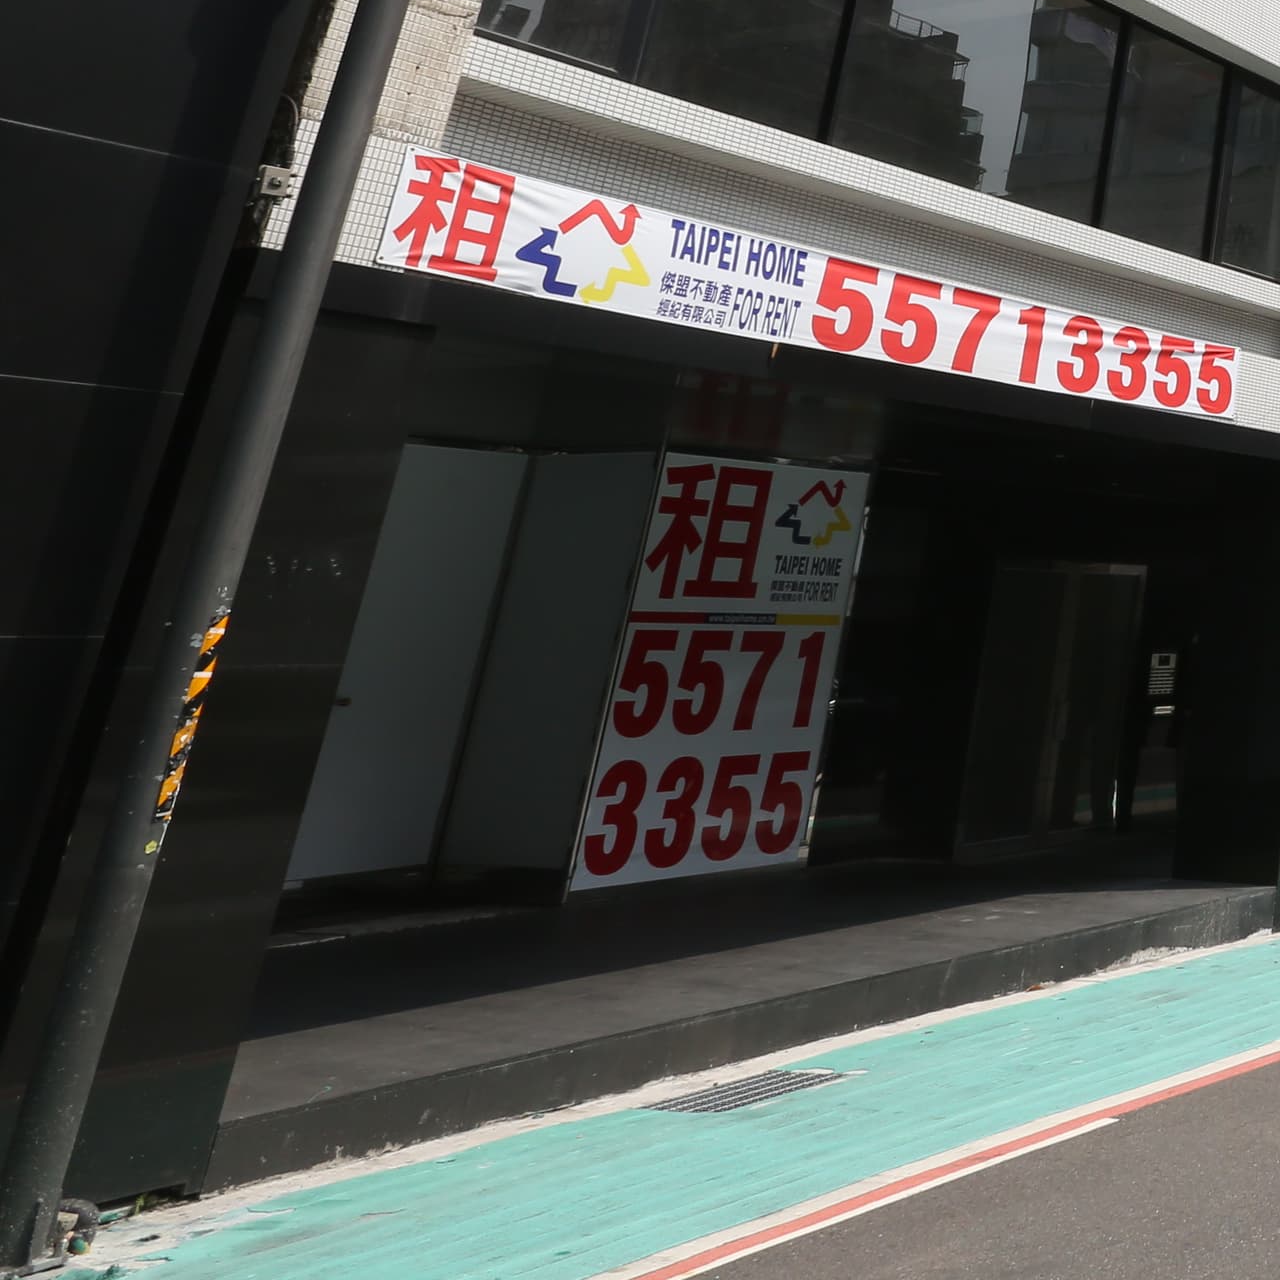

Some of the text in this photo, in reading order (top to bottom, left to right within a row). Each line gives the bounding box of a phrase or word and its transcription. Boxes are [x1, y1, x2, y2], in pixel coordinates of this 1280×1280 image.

[393, 155, 516, 282] 租
[671, 218, 808, 287] TAIPEI HOME
[659, 271, 734, 307] 傑盟不動產
[728, 287, 802, 339] FOR RENT
[811, 257, 1236, 414] 55713355
[645, 463, 774, 600] 租
[775, 555, 843, 577] TAIPEI HOME
[803, 581, 820, 601] FOR
[820, 582, 839, 602] RENT
[613, 630, 826, 738] 5571
[584, 751, 811, 876] 3355
